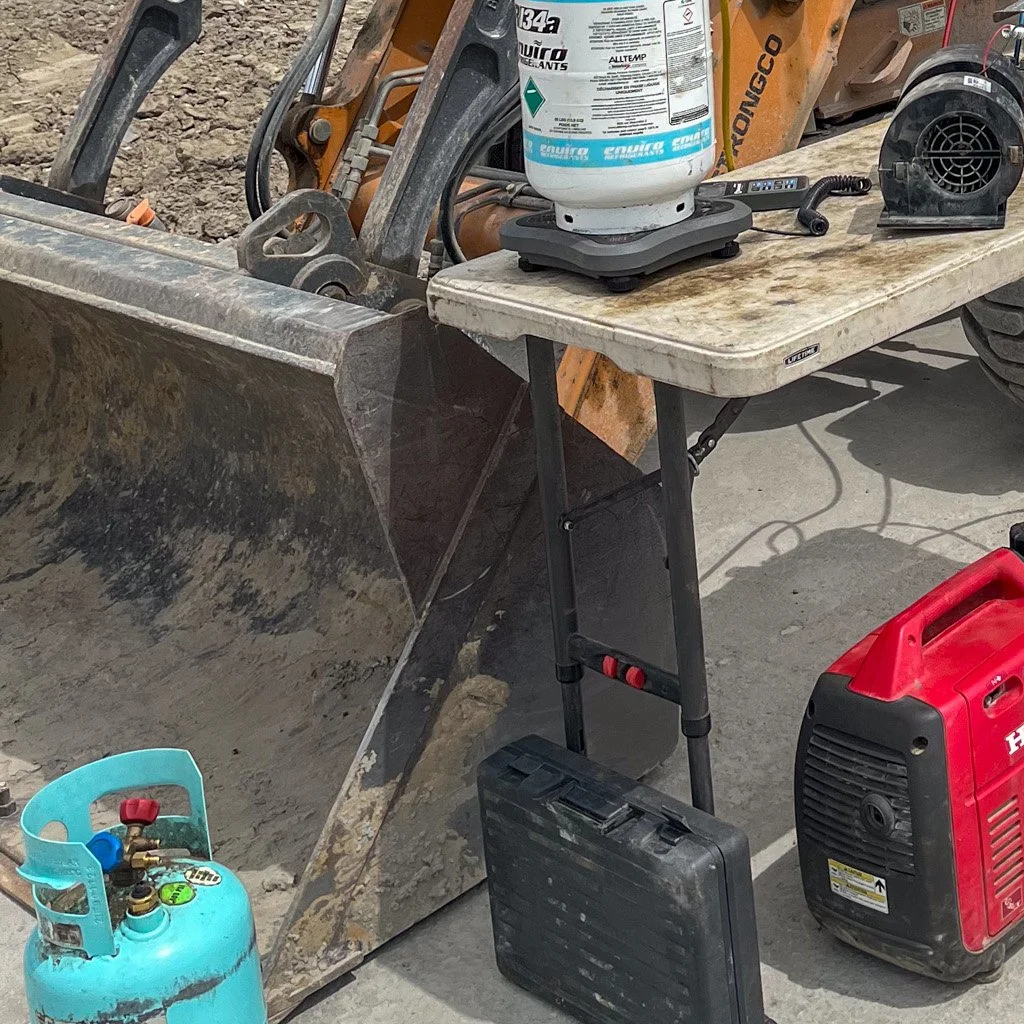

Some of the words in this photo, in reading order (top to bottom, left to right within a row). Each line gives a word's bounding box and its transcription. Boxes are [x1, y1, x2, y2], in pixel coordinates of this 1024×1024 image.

[608, 54, 646, 64] ALLTEMP
[540, 144, 589, 155] enviro
[604, 140, 665, 155] enviro
[788, 347, 815, 364] LIFETIME
